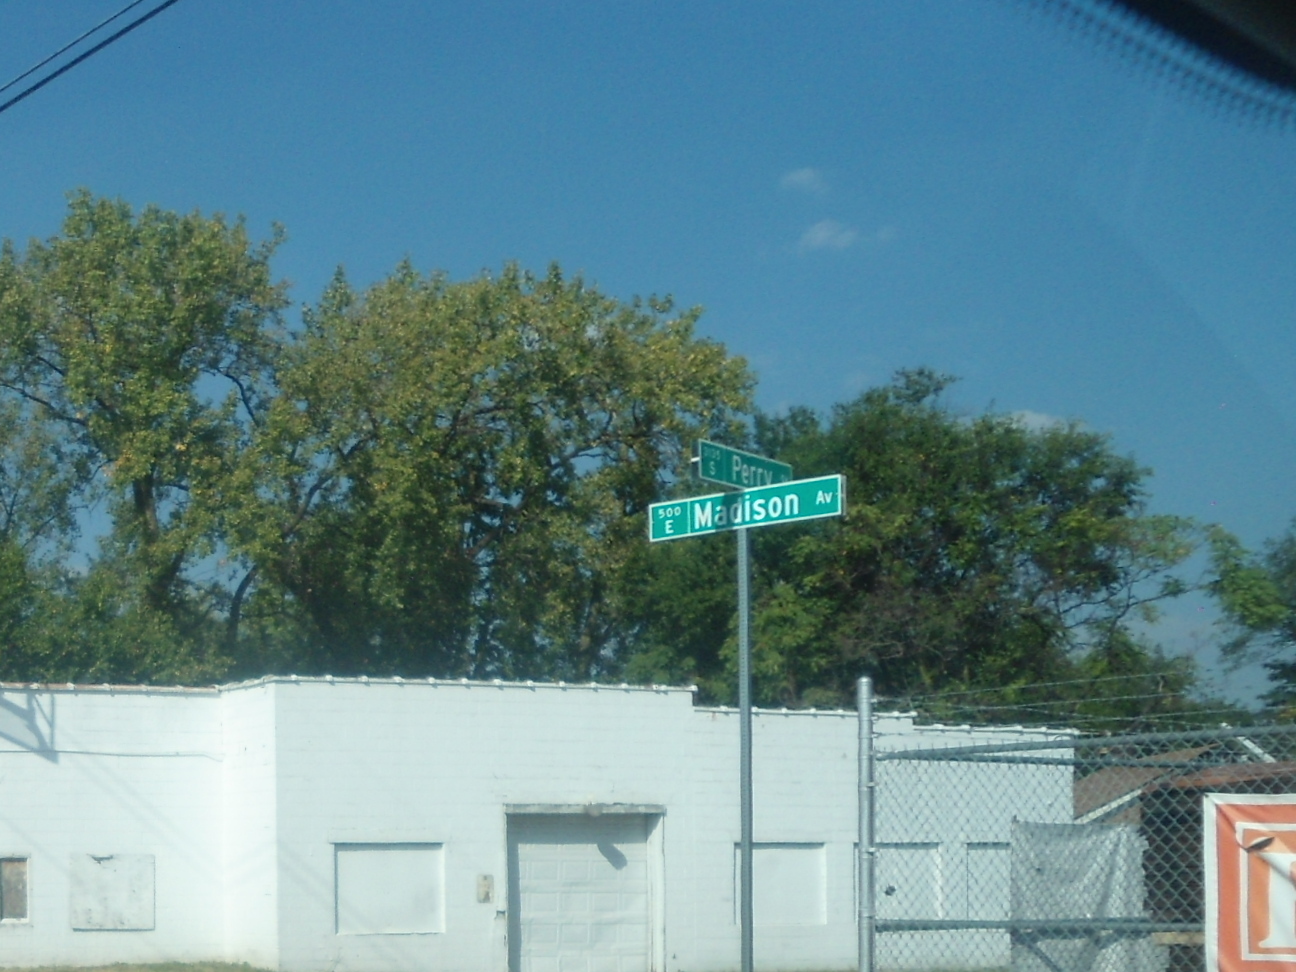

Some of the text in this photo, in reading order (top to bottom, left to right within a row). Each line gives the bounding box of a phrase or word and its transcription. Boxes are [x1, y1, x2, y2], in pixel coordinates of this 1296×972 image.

[709, 461, 716, 476] S
[732, 455, 773, 486] Perry
[657, 506, 682, 519] 500
[694, 490, 833, 530] Madison Av
[664, 519, 674, 534] E
